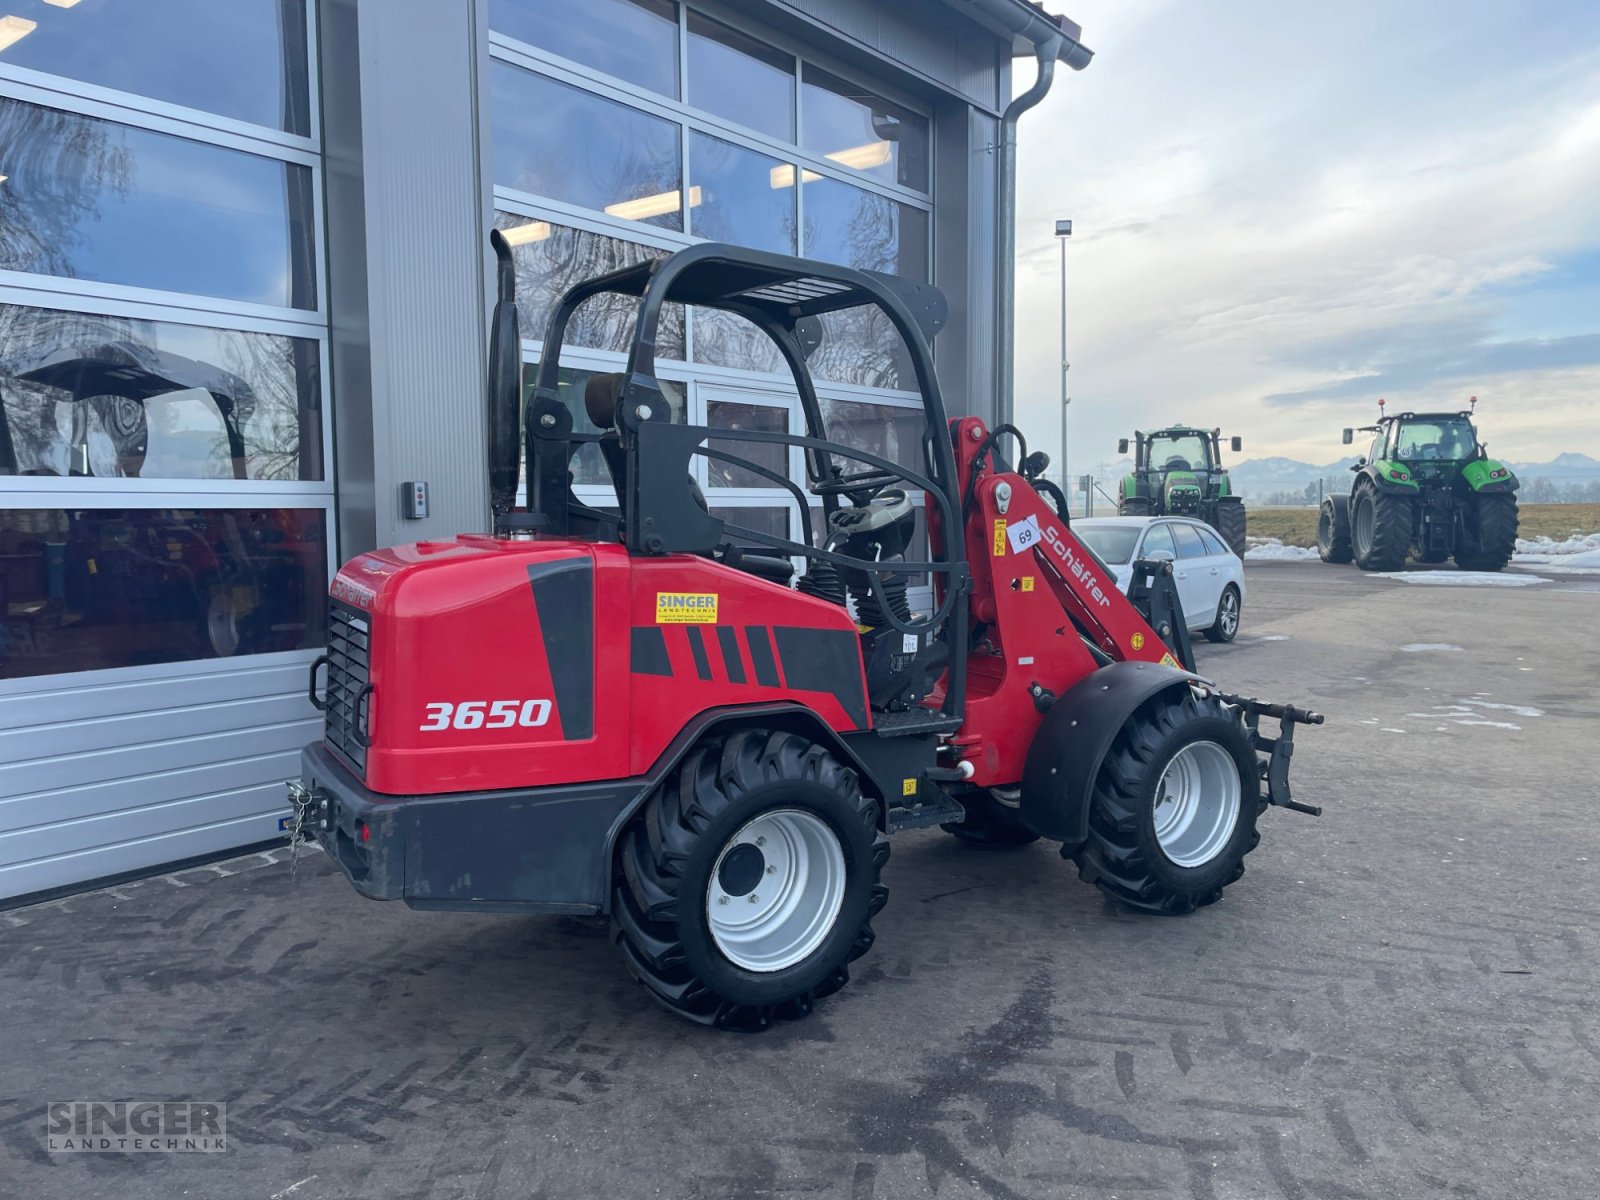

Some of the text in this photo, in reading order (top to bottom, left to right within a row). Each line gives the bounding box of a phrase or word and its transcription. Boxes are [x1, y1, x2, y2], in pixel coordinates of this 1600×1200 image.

[1019, 529, 1032, 544] 69
[1039, 526, 1110, 607] Schäffer
[659, 595, 715, 608] SINGER
[419, 699, 552, 731] 3650
